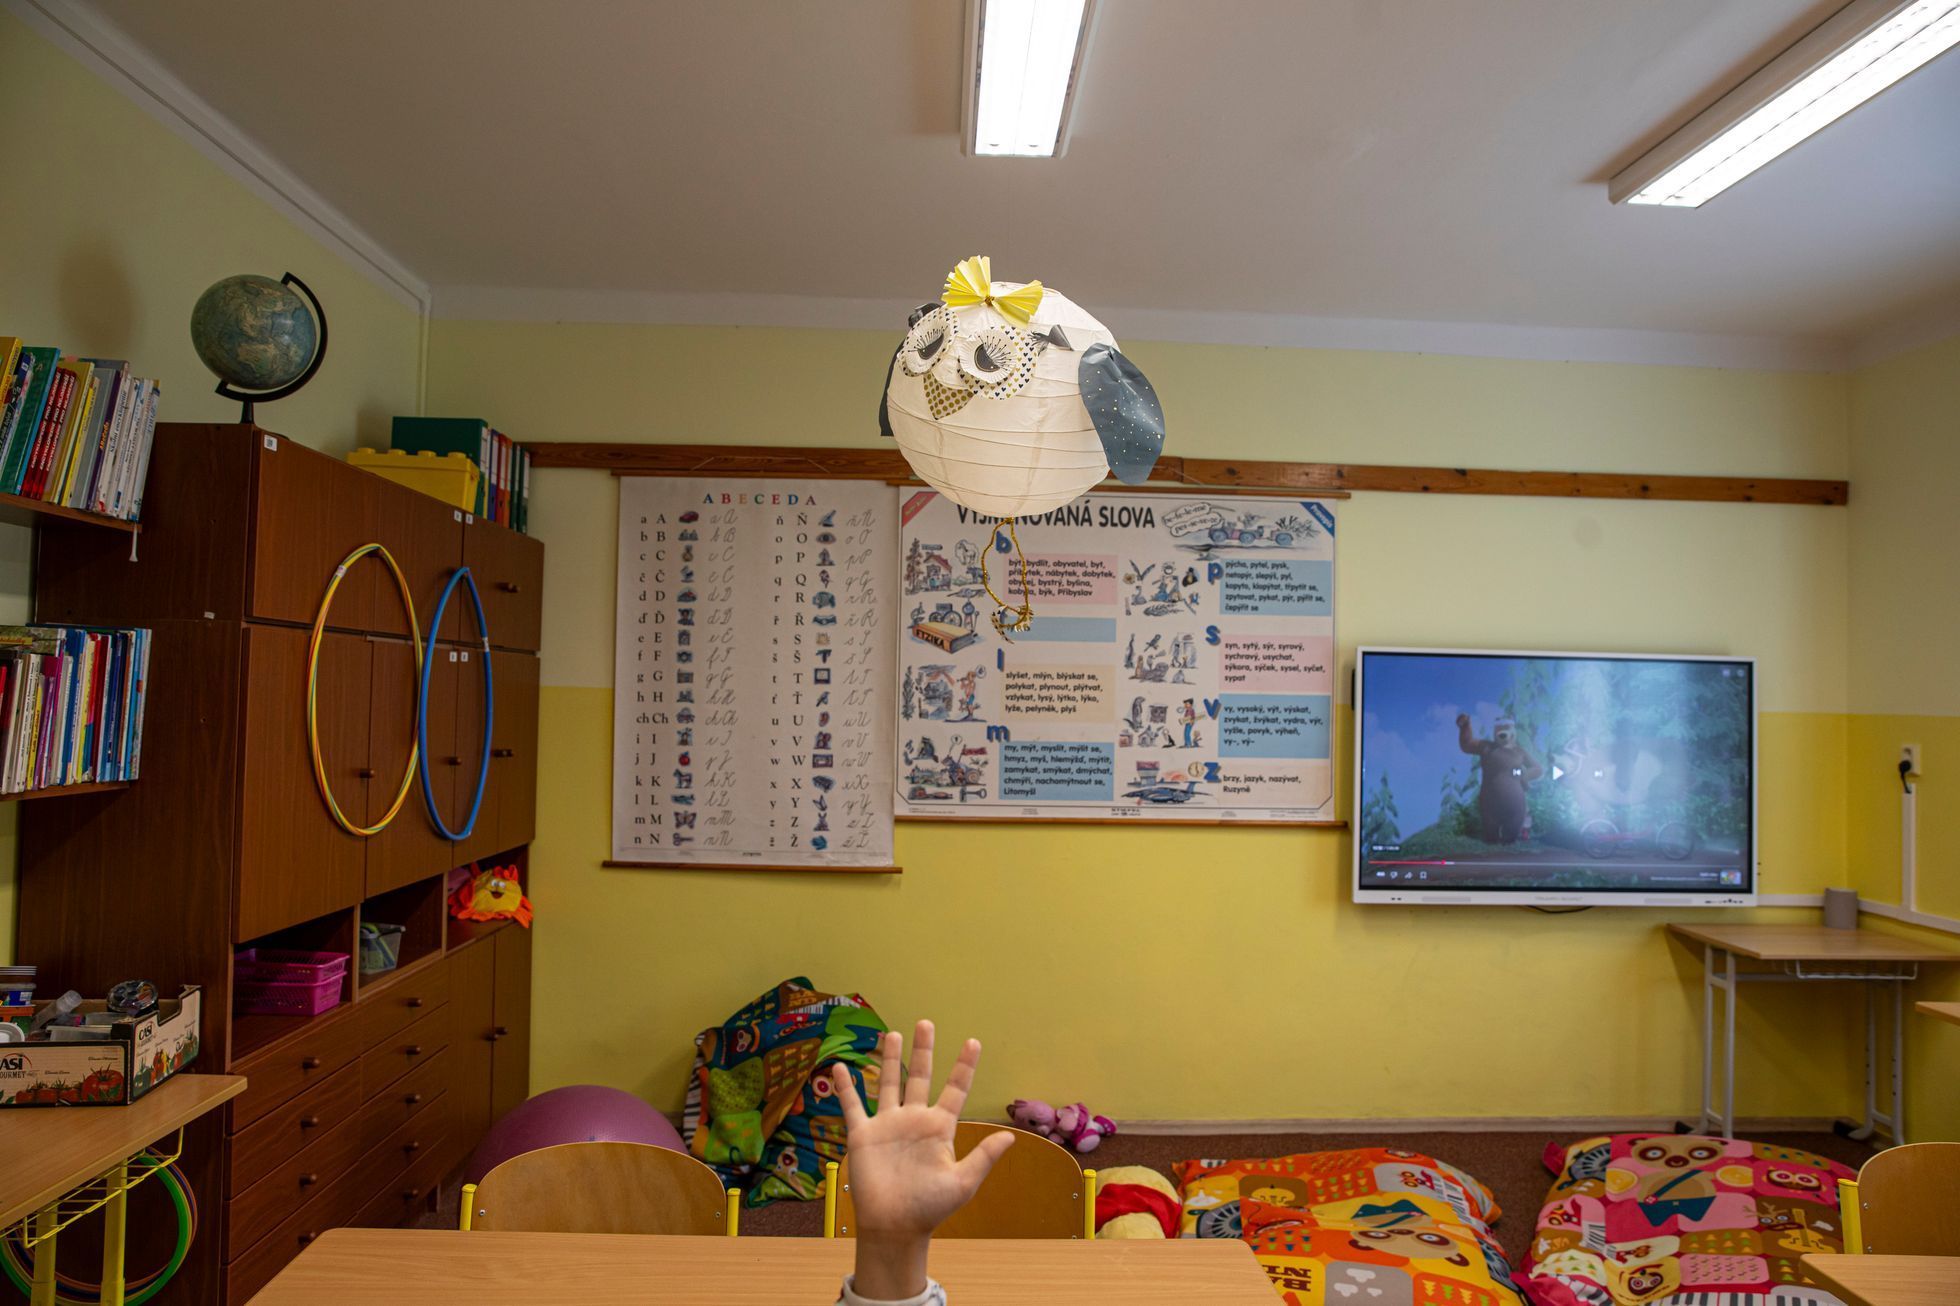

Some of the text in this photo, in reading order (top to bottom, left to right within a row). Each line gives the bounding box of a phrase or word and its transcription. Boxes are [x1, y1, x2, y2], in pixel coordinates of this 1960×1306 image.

[656, 514, 666, 524] A
[798, 512, 807, 525] Ň
[1099, 506, 1155, 528] SLOVA
[657, 532, 666, 542] B
[797, 533, 807, 543] O
[656, 550, 665, 560] C
[797, 552, 805, 562] P
[656, 570, 664, 583] Č
[796, 574, 806, 586] Q
[656, 591, 665, 601] D
[796, 592, 804, 602] R
[656, 611, 664, 624] Ď
[796, 612, 804, 626] Ř
[654, 632, 662, 643] E
[794, 634, 801, 644] S
[1205, 625, 1221, 646] s
[654, 650, 661, 661] F
[794, 650, 800, 663] Š
[653, 671, 662, 681] G
[793, 673, 803, 684] T
[1006, 671, 1030, 680] slyšet,
[1033, 672, 1054, 680] mlýn,
[1056, 672, 1085, 680] blýskat
[1005, 682, 1103, 692] polykat, plynout, plýtvat,
[654, 692, 662, 702] H
[793, 692, 802, 704] Ť
[1006, 694, 1099, 703] vzlykat, lysý, lýtko, lýko,
[1005, 704, 1076, 714] lyže, pelyněk, plyš
[1203, 698, 1222, 720] v
[652, 713, 668, 724] Ch
[794, 715, 803, 726] U
[987, 724, 1010, 742] m
[652, 734, 656, 744] I
[792, 736, 802, 746] V
[650, 753, 655, 765] J
[792, 755, 806, 765] W
[652, 776, 660, 786] K
[792, 778, 801, 789] X
[651, 794, 658, 805] L
[792, 798, 800, 808] Y
[651, 814, 662, 824] M
[791, 817, 798, 827] Z
[650, 834, 660, 844] N
[791, 834, 798, 847] Ž
